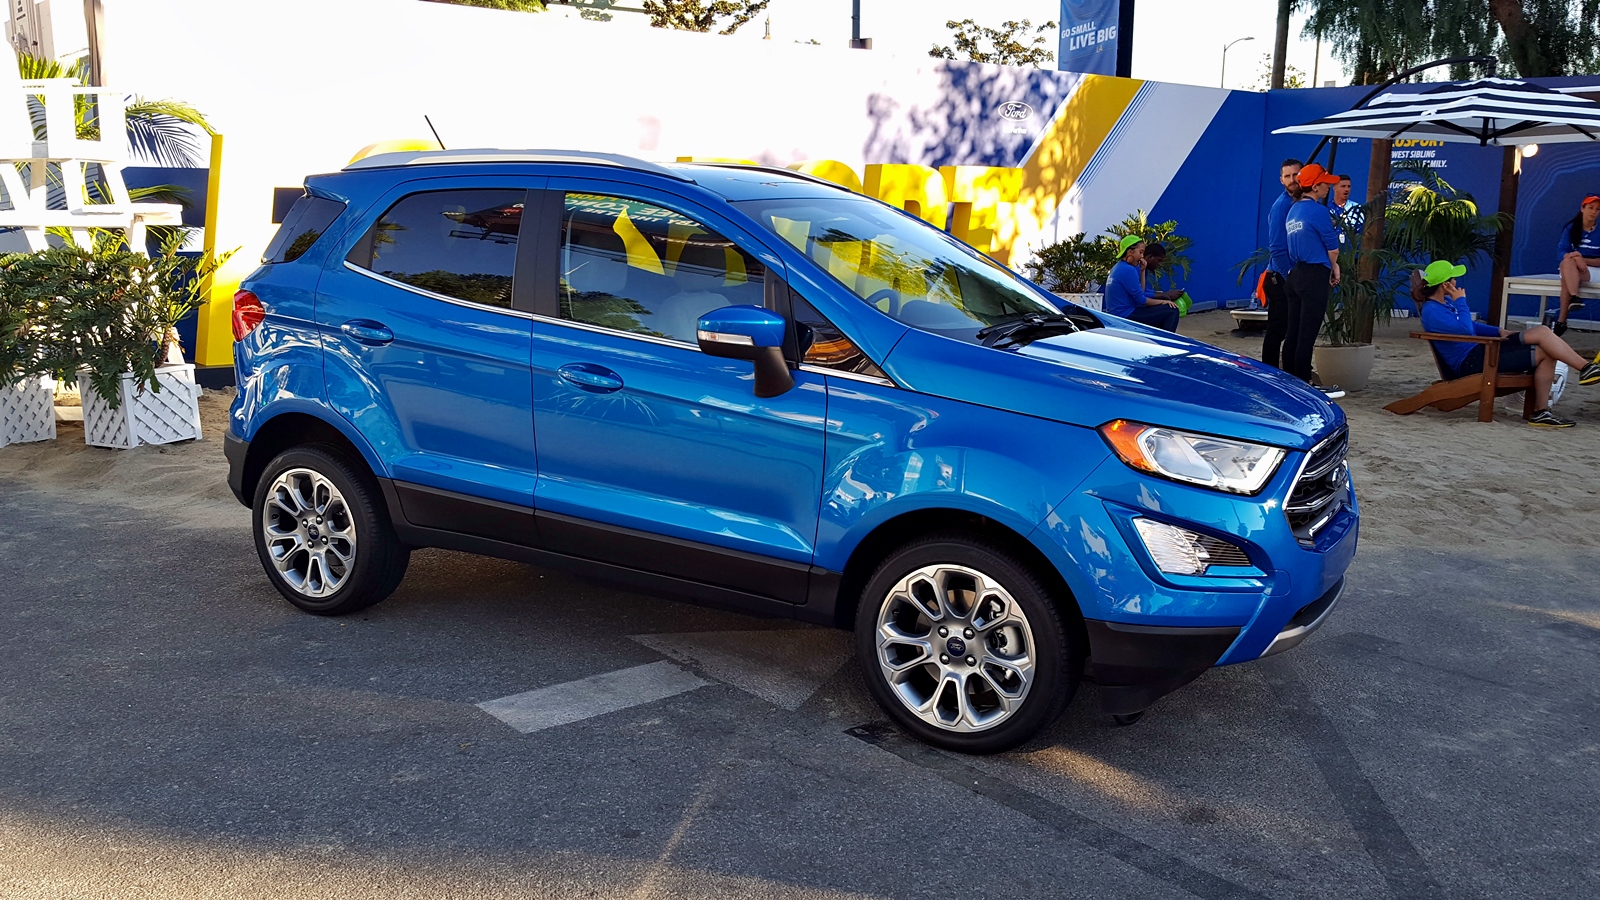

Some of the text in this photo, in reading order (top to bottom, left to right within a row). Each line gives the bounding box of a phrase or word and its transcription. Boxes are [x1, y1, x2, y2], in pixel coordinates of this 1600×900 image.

[1061, 21, 1096, 39] GO SMALL
[1069, 25, 1117, 51] LIVE BIG
[1004, 103, 1027, 119] Ford
[1337, 136, 1359, 144] Further
[1409, 150, 1436, 158] SIBLING
